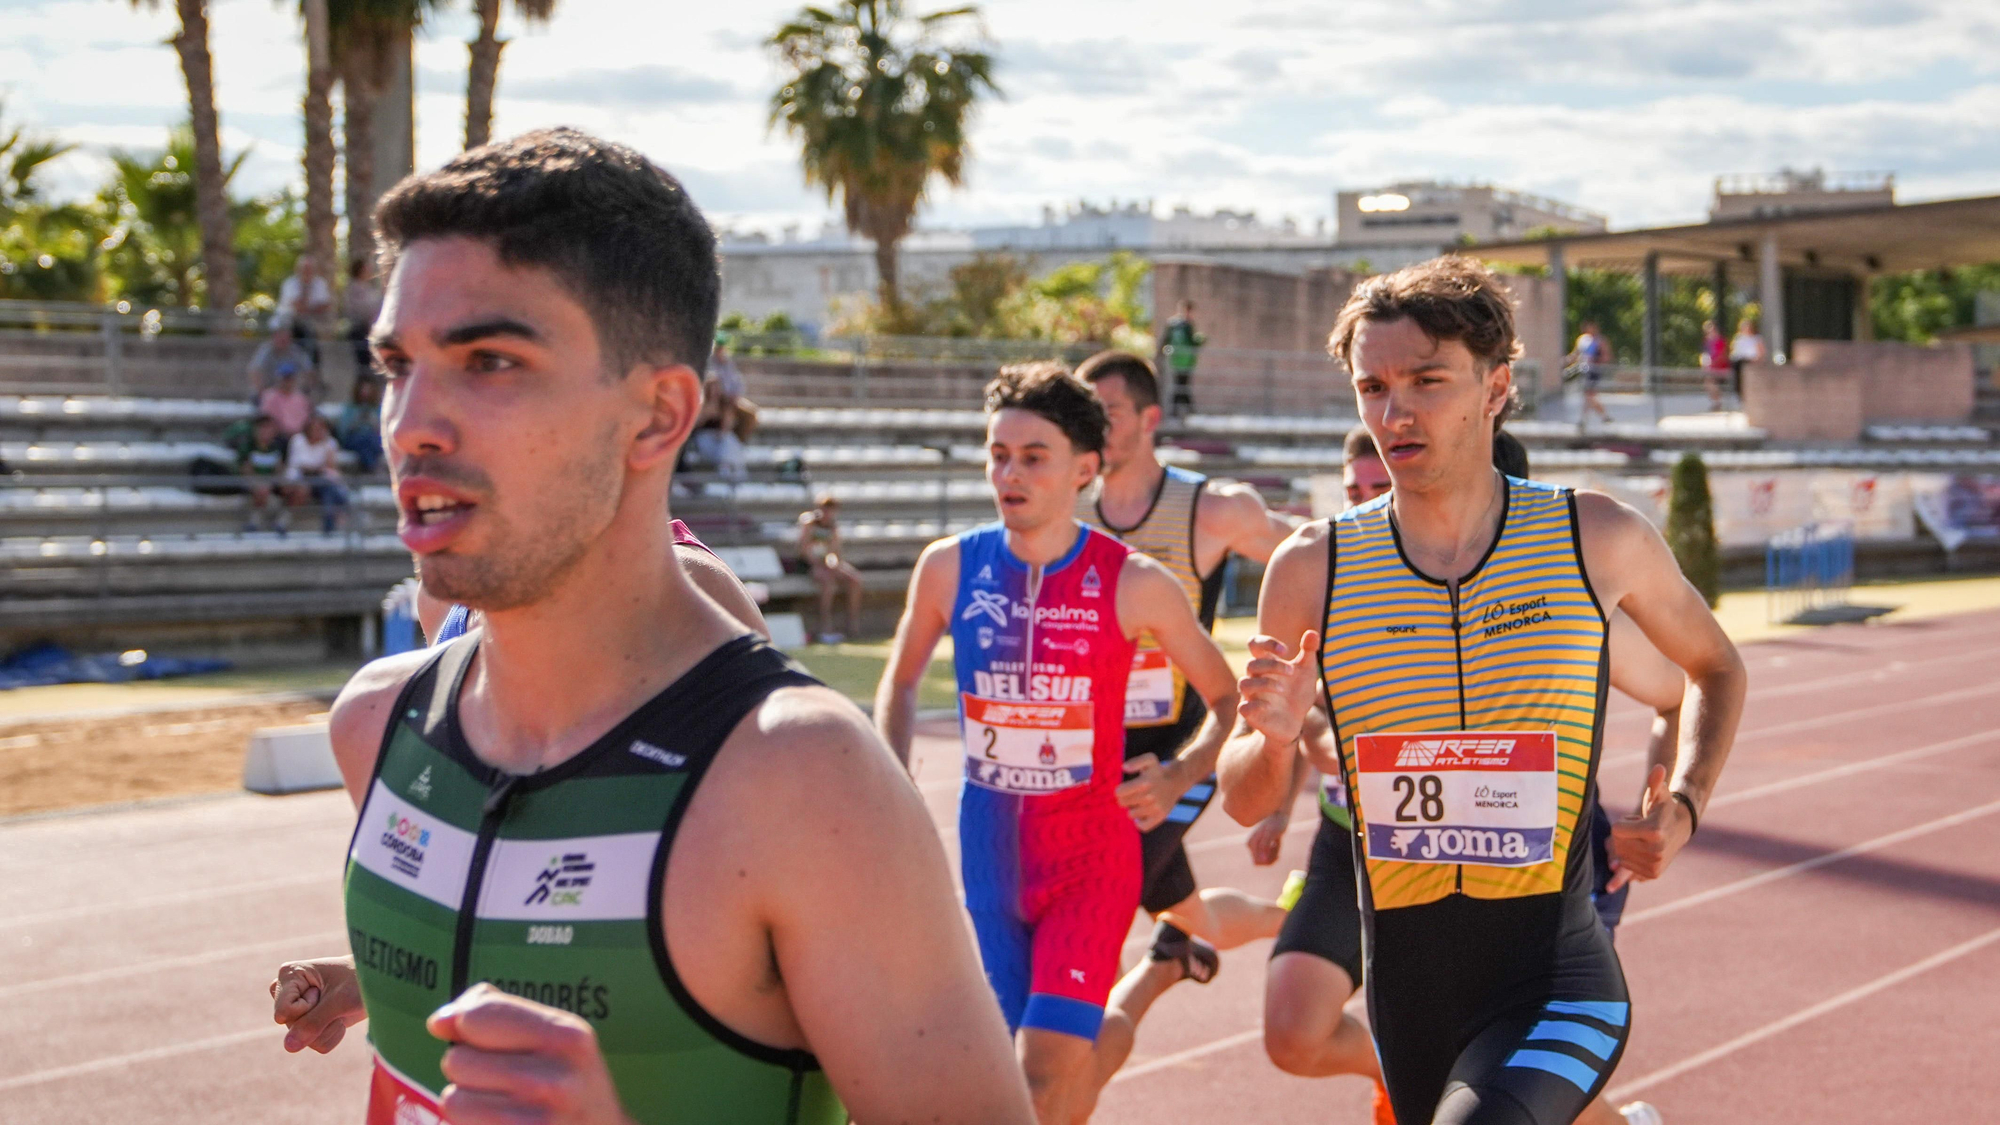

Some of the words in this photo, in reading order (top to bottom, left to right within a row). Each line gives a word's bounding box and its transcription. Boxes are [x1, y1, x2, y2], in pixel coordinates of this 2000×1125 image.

[1011, 601, 1029, 619] la
[1035, 604, 1099, 625] palma
[1509, 595, 1548, 616] Esport
[1484, 611, 1552, 638] MENORCA
[974, 670, 1025, 700] DEL
[1031, 674, 1092, 701] SUR
[983, 727, 998, 760] 2
[1439, 740, 1517, 757] RFEA
[1435, 757, 1510, 766] ATLETISMO
[1393, 774, 1444, 822] 28
[1475, 801, 1519, 809] MENORCA
[1492, 790, 1517, 800] Esport
